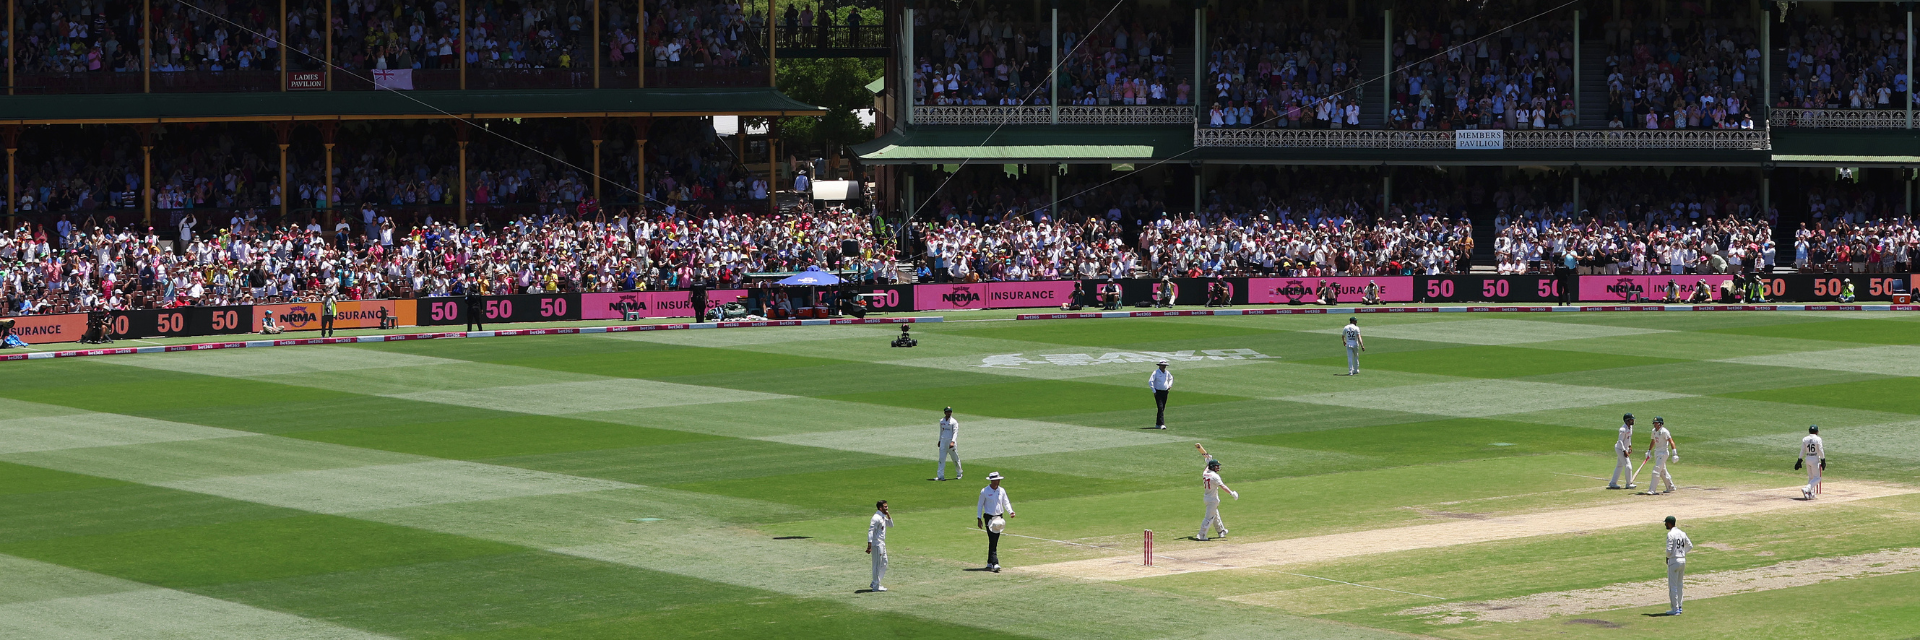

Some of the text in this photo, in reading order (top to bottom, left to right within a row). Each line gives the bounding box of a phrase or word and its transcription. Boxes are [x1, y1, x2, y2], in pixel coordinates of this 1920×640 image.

[1427, 279, 1454, 298] 50
[1482, 279, 1509, 298] 50
[1761, 278, 1893, 296] 50 50 50
[872, 289, 899, 308] 50
[942, 290, 1054, 302] NRMA INSURANCE
[431, 297, 567, 321] 50 50 50
[158, 313, 183, 333] 50
[212, 310, 238, 330] 50
[280, 312, 317, 323] NRMA
[10, 325, 61, 336] SURANCE
[1807, 443, 1816, 453] 16
[1677, 538, 1685, 549] 94
